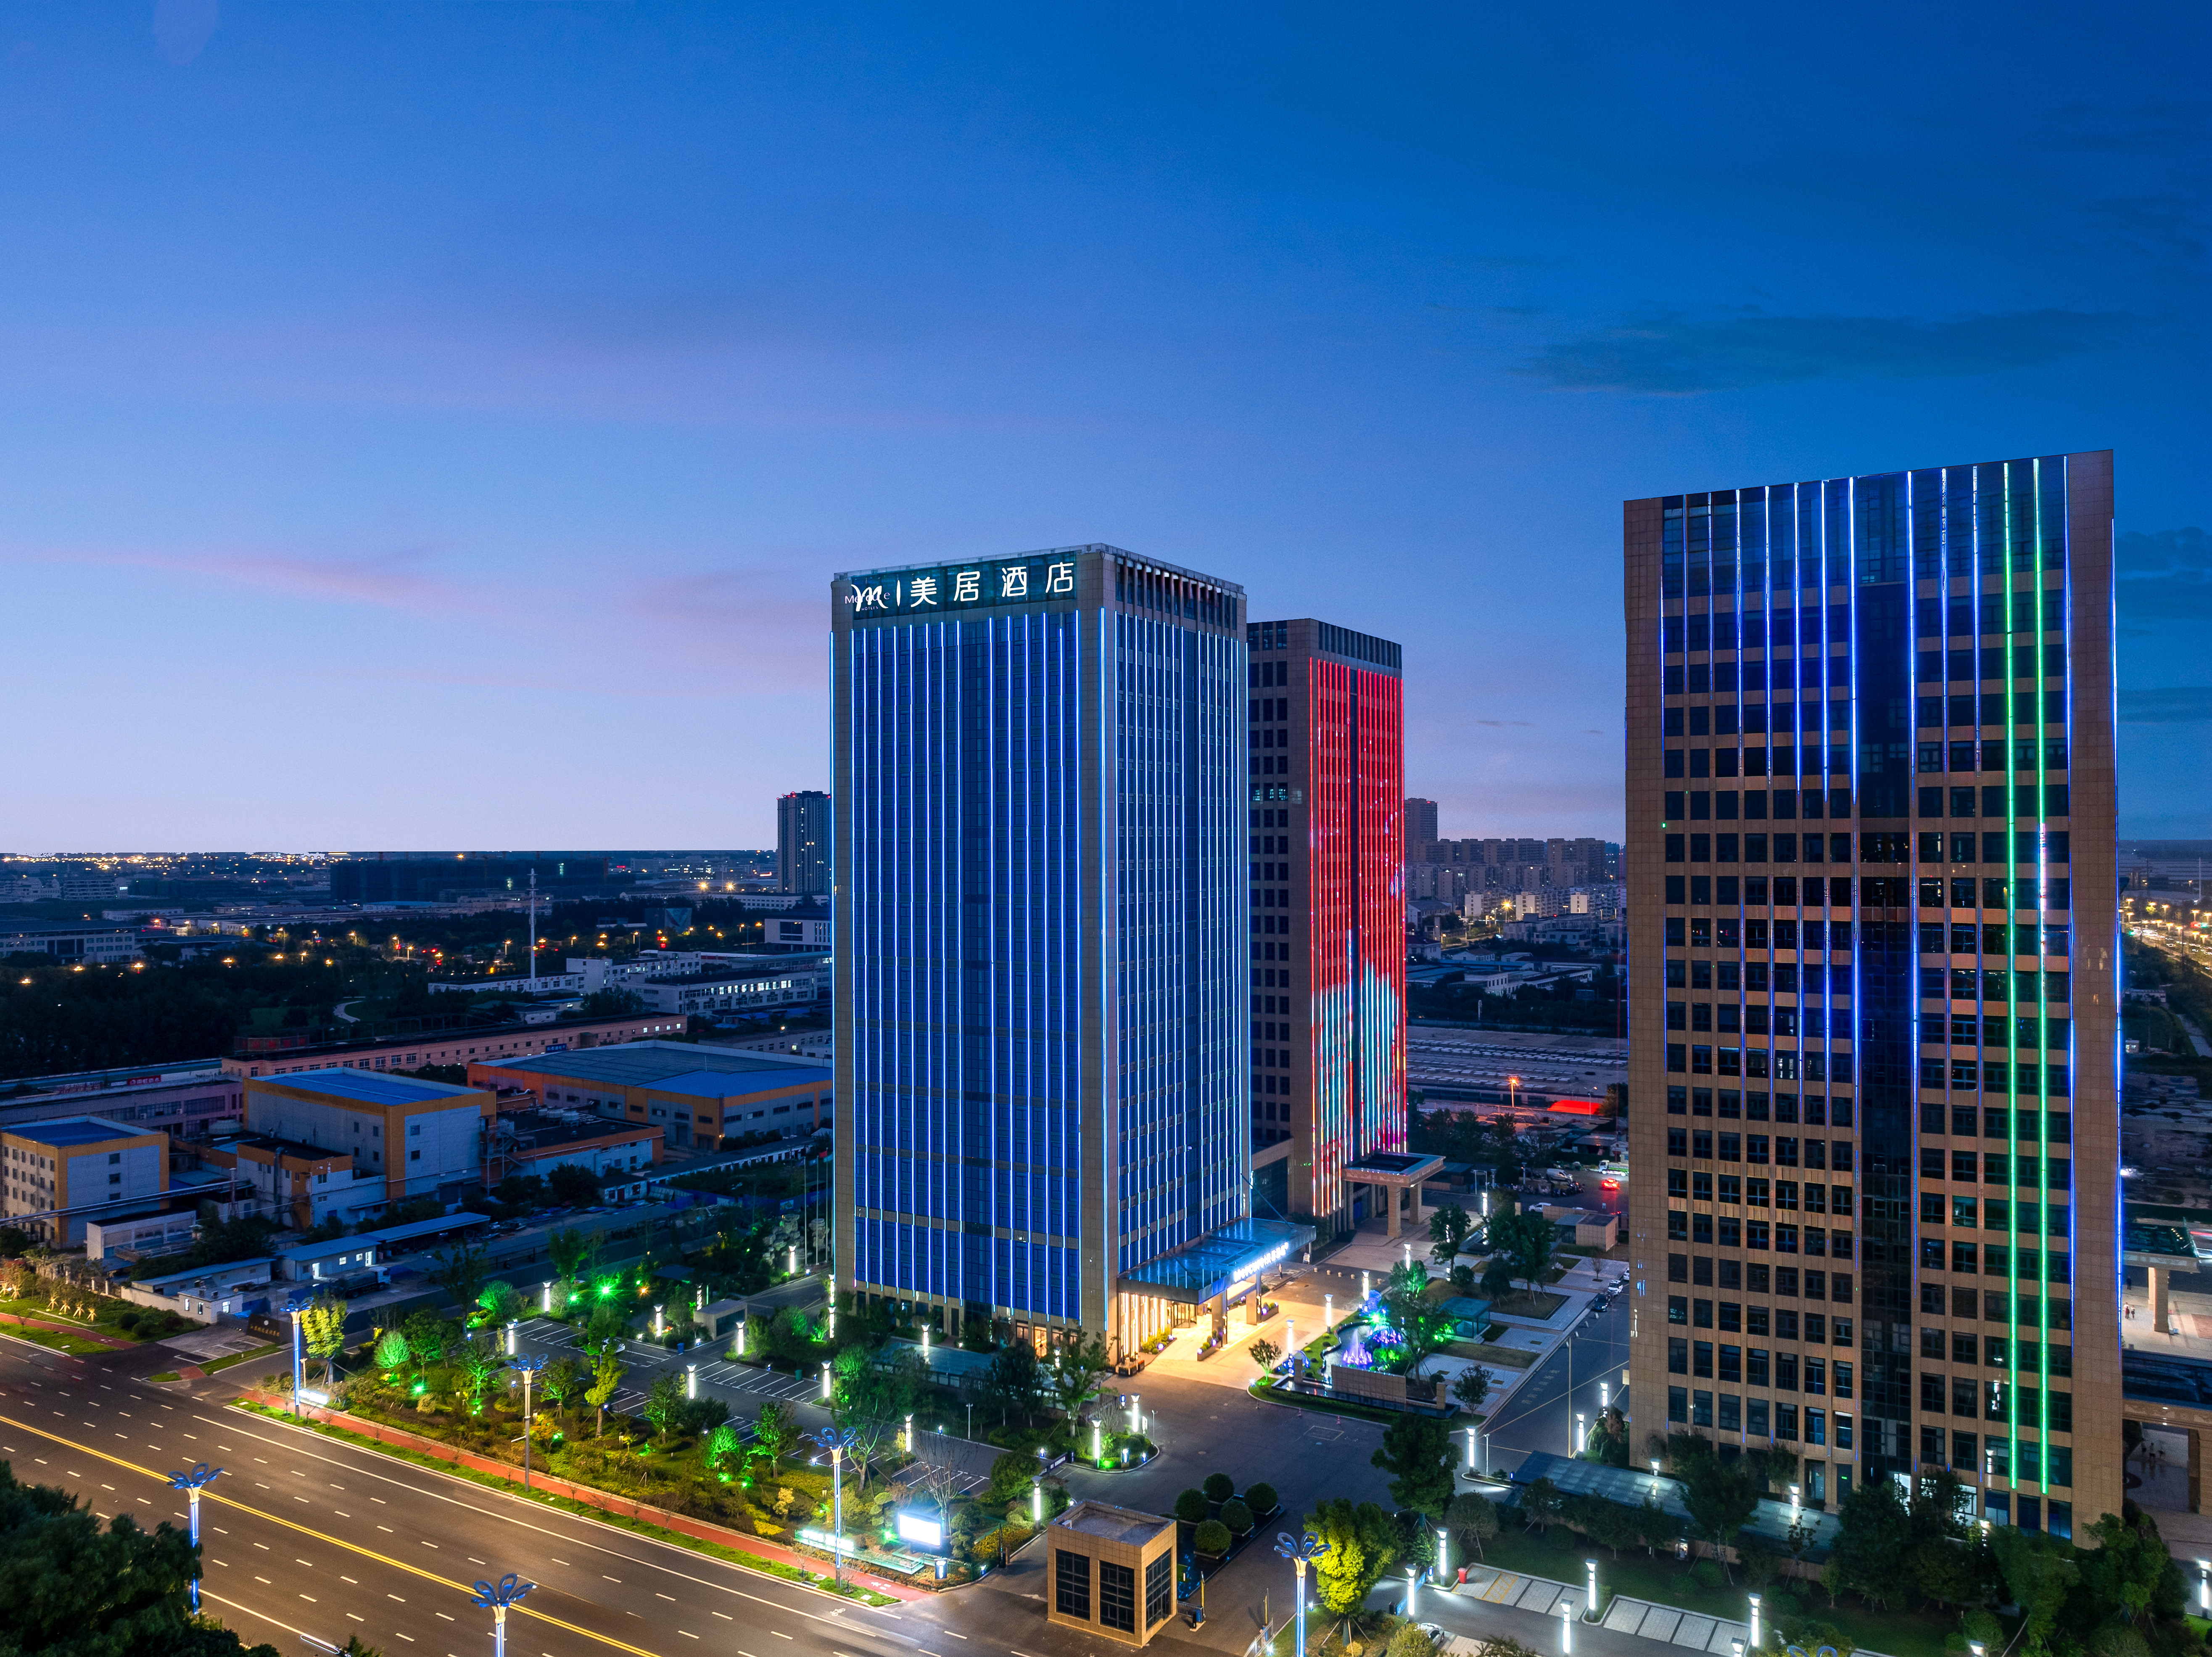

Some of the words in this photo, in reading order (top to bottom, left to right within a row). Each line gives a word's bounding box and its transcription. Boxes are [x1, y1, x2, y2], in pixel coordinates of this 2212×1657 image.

[845, 592, 890, 604] Mercue
[910, 561, 1074, 608] 美居酒店
